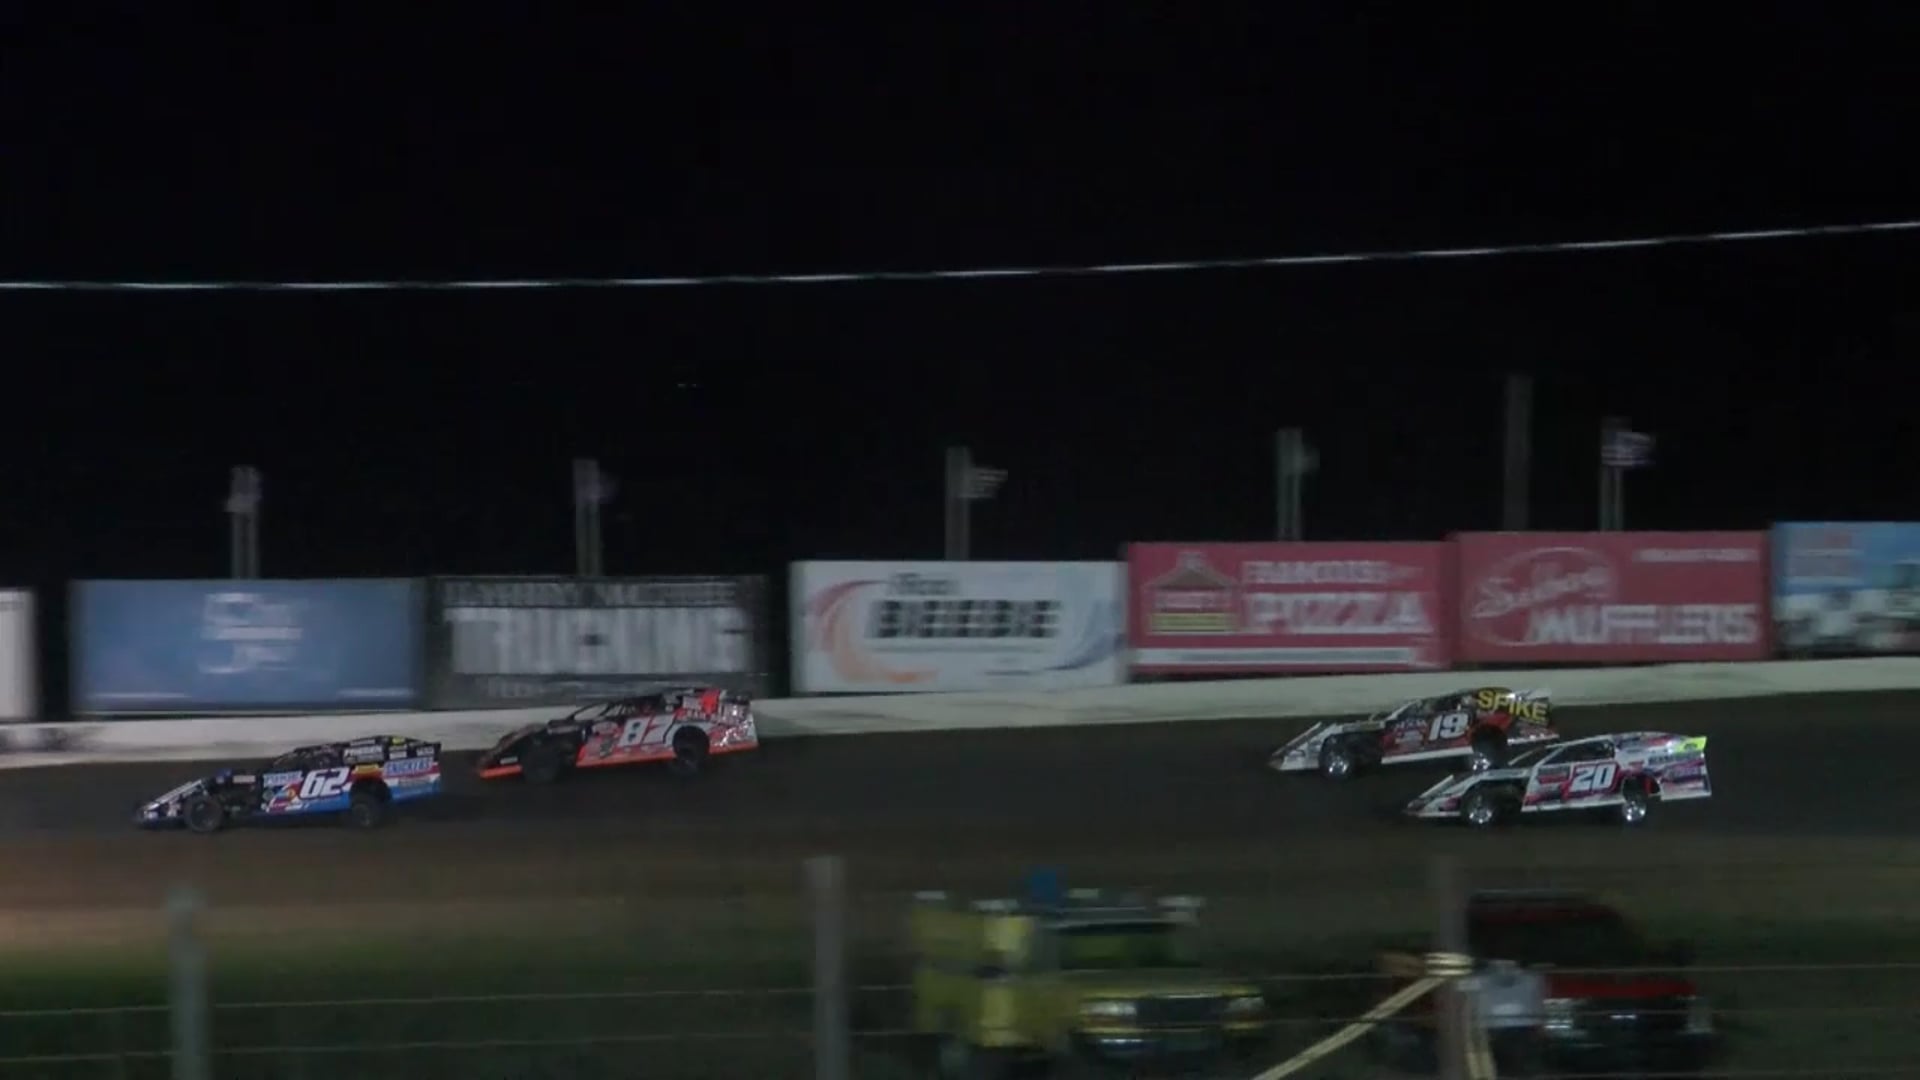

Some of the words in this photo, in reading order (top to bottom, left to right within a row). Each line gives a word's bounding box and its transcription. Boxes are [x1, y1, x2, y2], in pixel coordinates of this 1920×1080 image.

[1246, 591, 1434, 635] PIZZA
[1528, 603, 1762, 646] MUFFLERS
[1477, 688, 1549, 721] SPIKE
[617, 714, 675, 747] 87
[1428, 711, 1469, 743] 19
[299, 766, 350, 799] 62
[1569, 762, 1617, 793] 20
